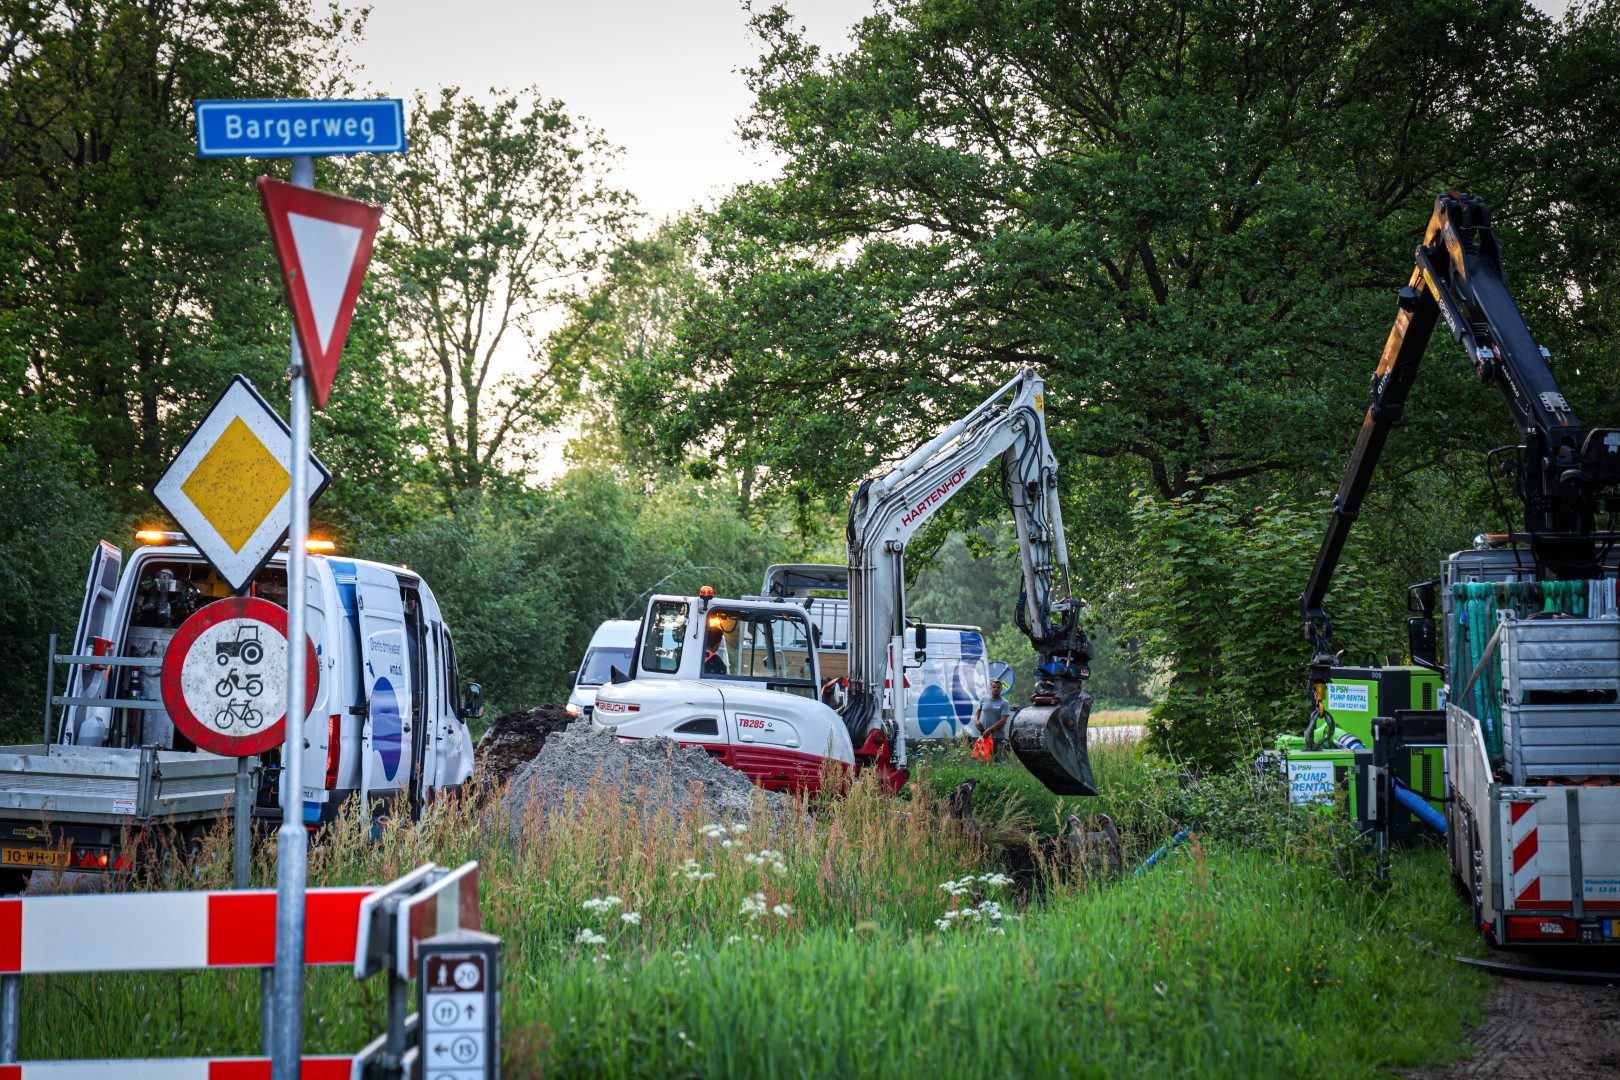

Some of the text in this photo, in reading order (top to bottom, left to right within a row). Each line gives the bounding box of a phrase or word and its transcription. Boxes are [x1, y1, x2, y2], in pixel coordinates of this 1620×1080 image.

[225, 114, 375, 146] Bargerweg
[901, 466, 967, 527] HARTENHOF
[1335, 685, 1349, 693] PSN
[1330, 693, 1367, 702] PUMP RENTAL
[738, 718, 765, 729] TB285
[1295, 772, 1327, 782] PUMP
[1292, 782, 1334, 792] RENTAL
[440, 1007, 453, 1020] 11
[458, 1043, 473, 1057] 15
